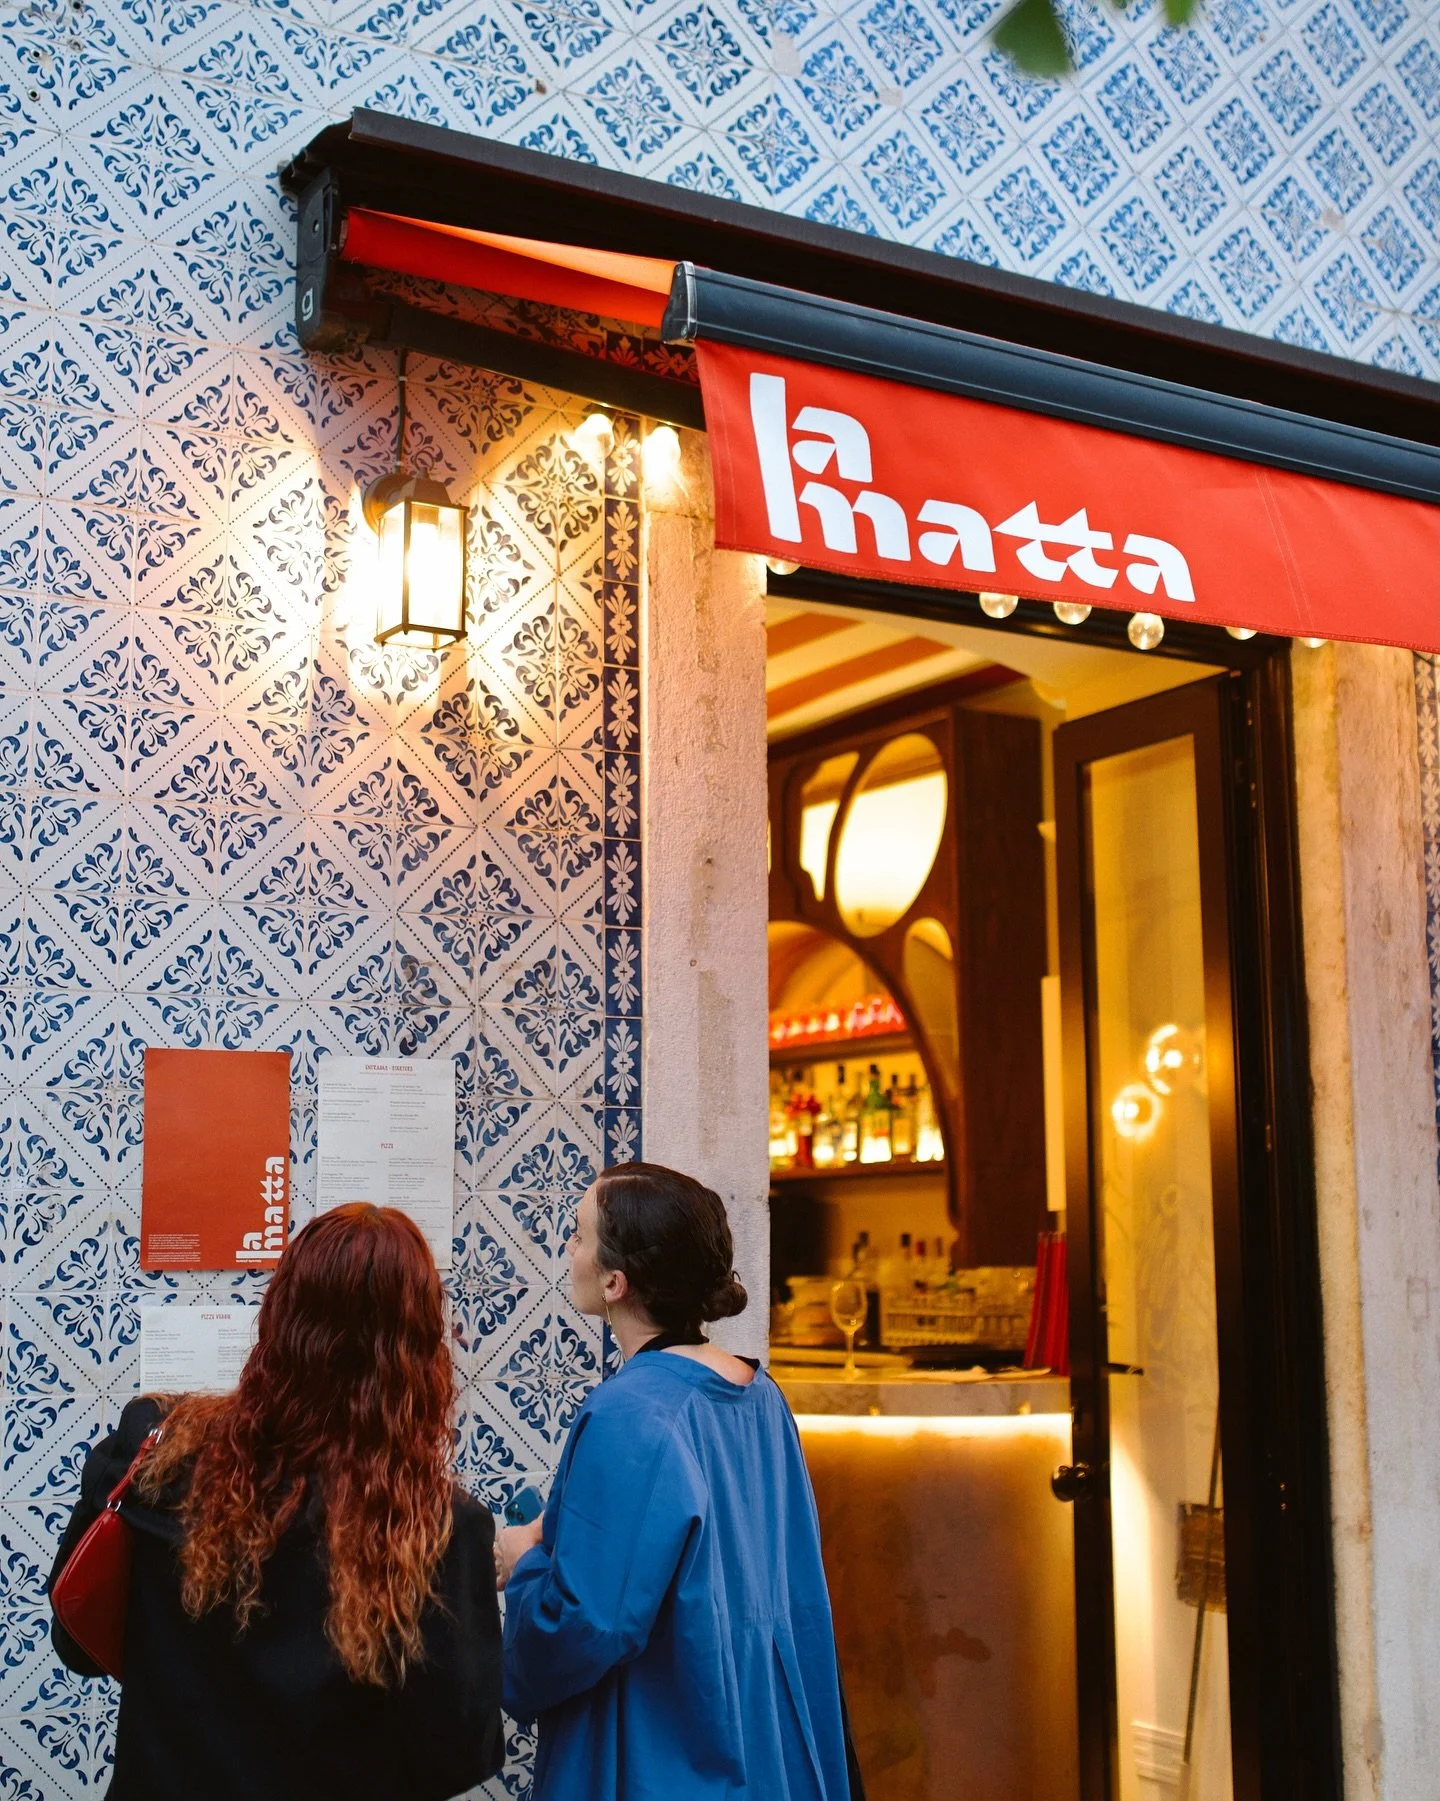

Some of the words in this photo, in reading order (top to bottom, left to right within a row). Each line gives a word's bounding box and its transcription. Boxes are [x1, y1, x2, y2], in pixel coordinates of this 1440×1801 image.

[749, 372, 872, 544] la
[797, 481, 1196, 603] matta
[235, 1231, 283, 1260] la
[259, 1156, 285, 1250] matta
